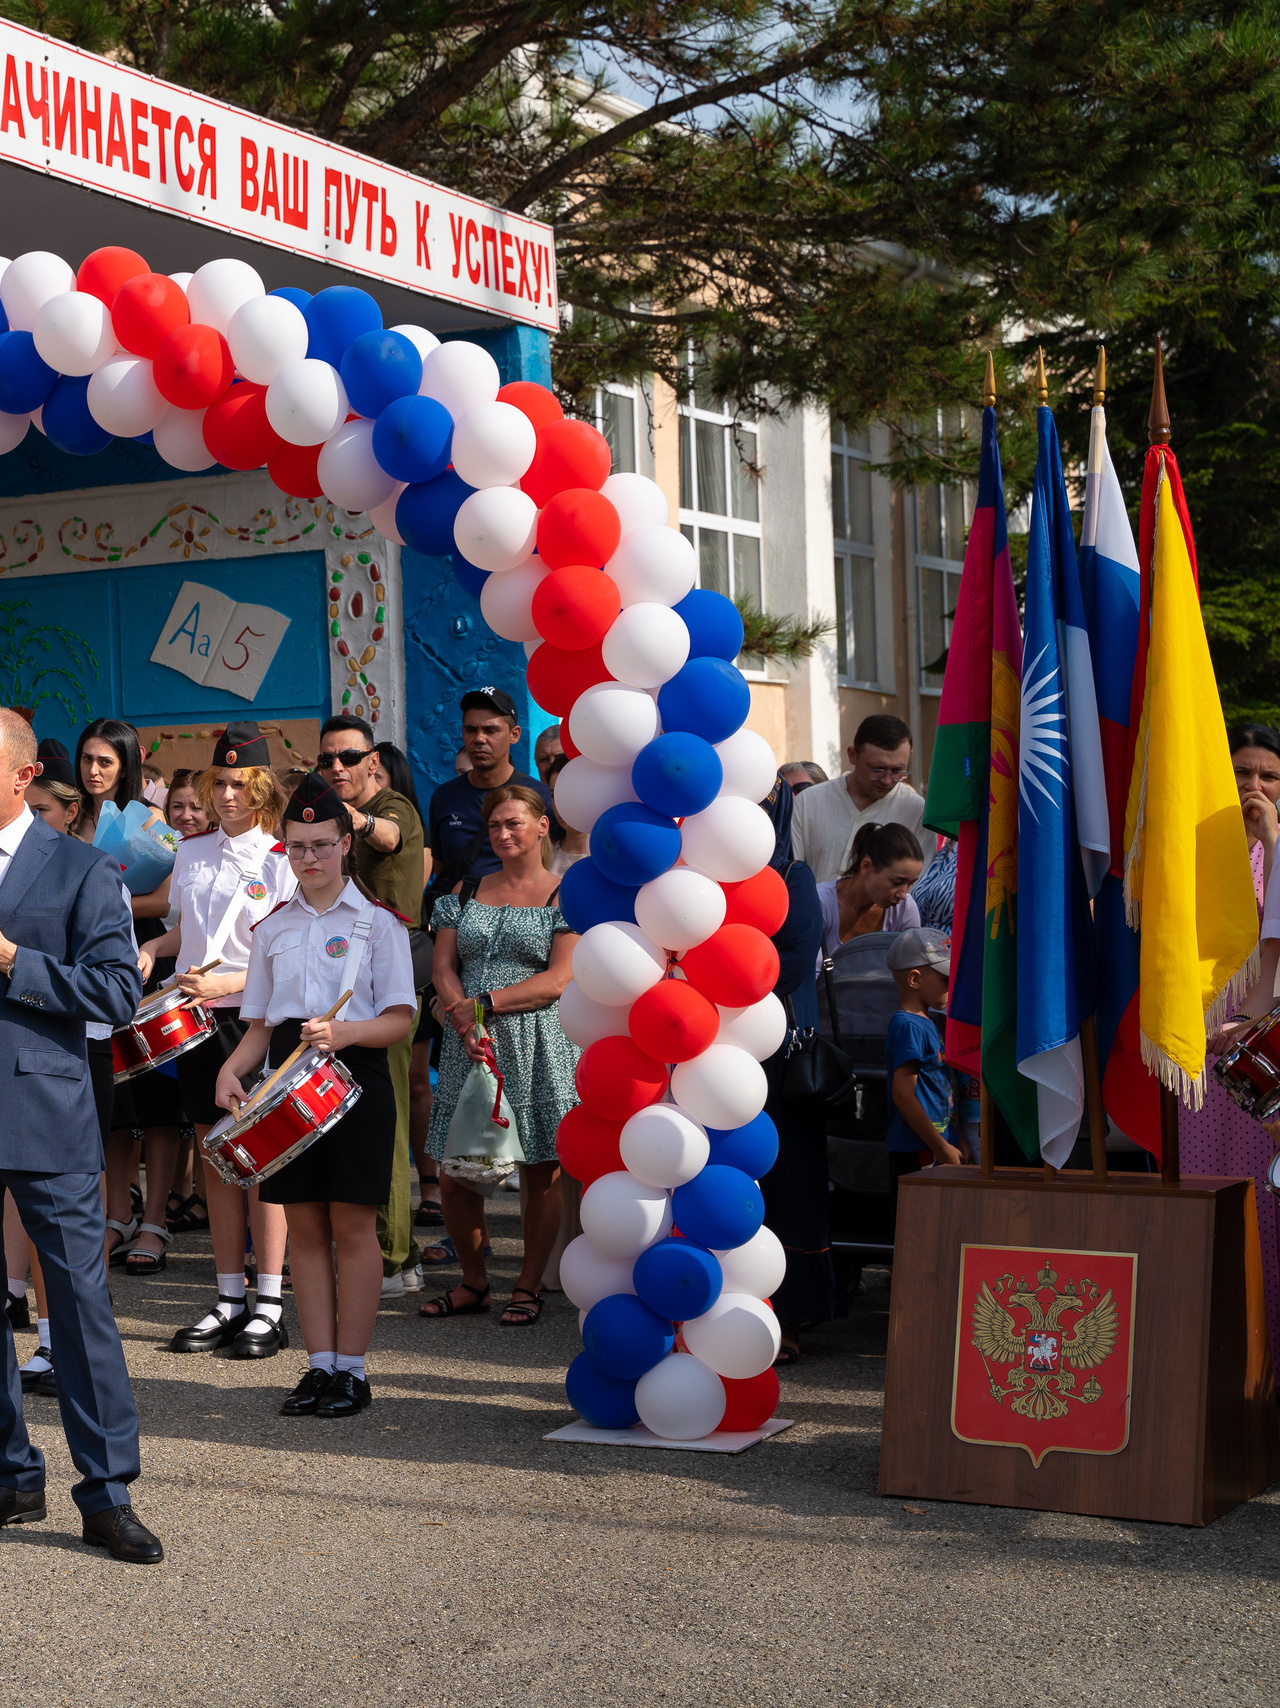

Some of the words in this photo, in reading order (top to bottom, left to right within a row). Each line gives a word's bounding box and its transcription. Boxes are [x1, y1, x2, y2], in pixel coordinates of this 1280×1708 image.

[240, 136, 309, 230] ВАШ
[325, 166, 397, 257] ПУТЬ
[415, 200, 432, 270] К
[449, 213, 553, 308] УСПЕХУ!
[222, 625, 266, 671] 5
